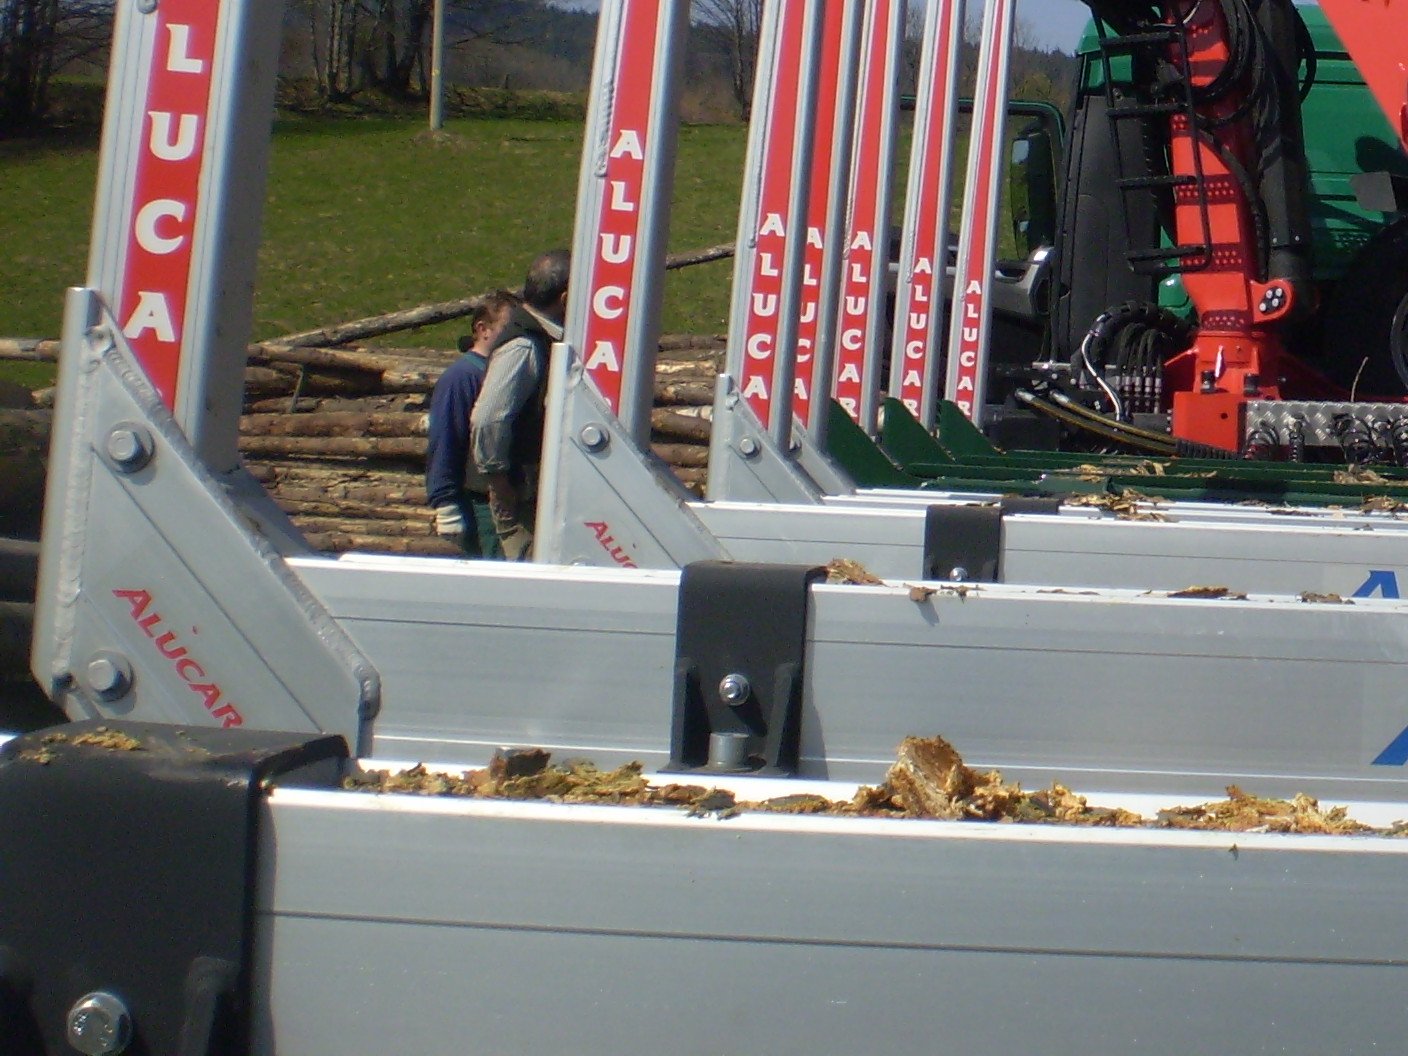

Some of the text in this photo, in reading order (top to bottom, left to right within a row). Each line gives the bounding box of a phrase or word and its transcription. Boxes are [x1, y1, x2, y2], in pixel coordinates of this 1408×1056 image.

[586, 129, 643, 373] ALUCA
[743, 213, 785, 400] ALUCA
[794, 227, 823, 400] ALUCA
[838, 231, 873, 418] ALUCAR
[903, 257, 932, 417] ALUCAR
[957, 280, 982, 416] ALUCAR
[112, 589, 243, 729] ALUCAR
